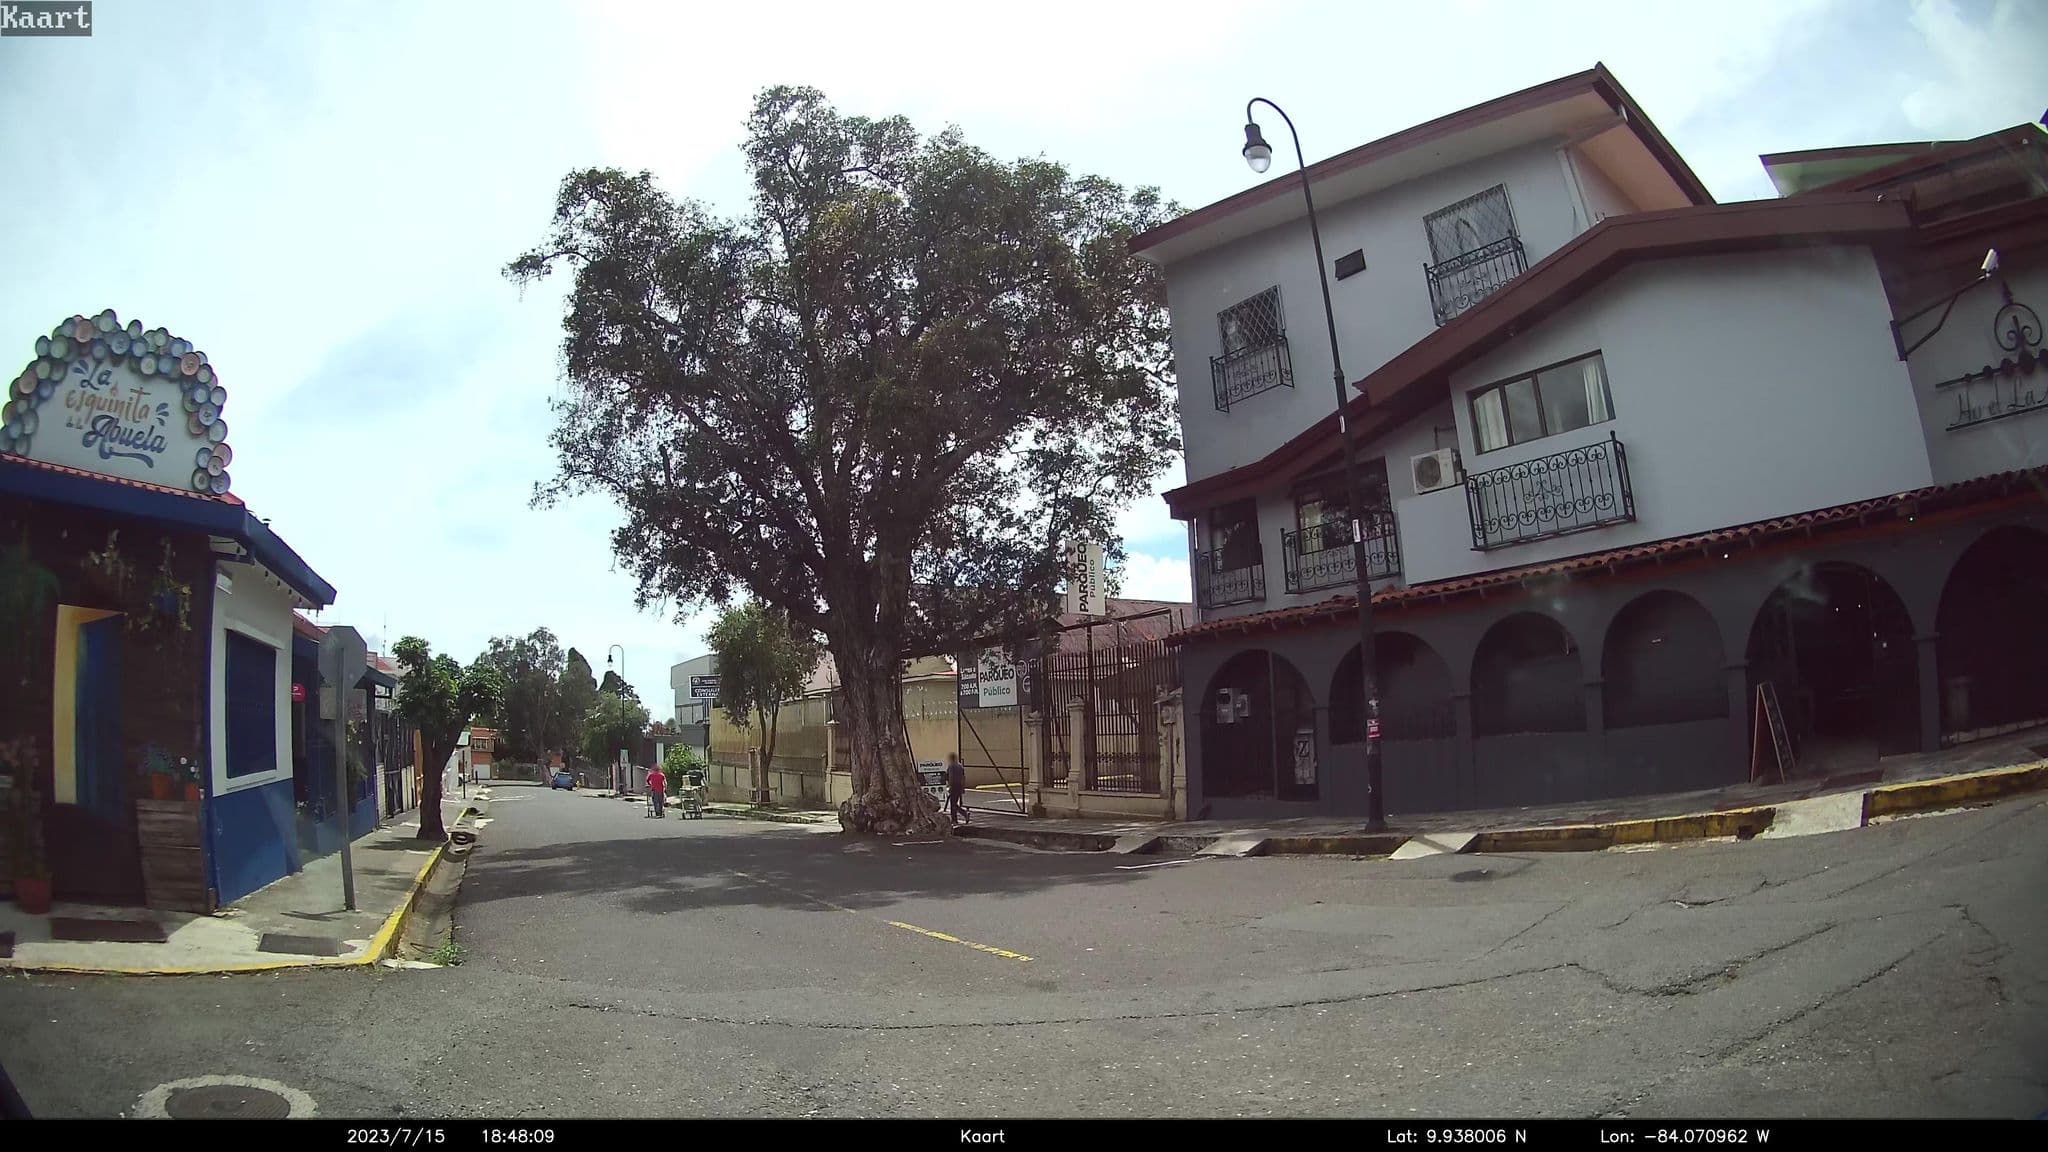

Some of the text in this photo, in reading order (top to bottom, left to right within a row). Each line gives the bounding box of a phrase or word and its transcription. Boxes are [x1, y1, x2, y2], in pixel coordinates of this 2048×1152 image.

[80, 360, 112, 390] La
[82, 414, 168, 466] Abuela
[1077, 539, 1089, 613] PARQUEO
[979, 668, 1015, 683] PARQUEO
[983, 686, 1011, 696] Público
